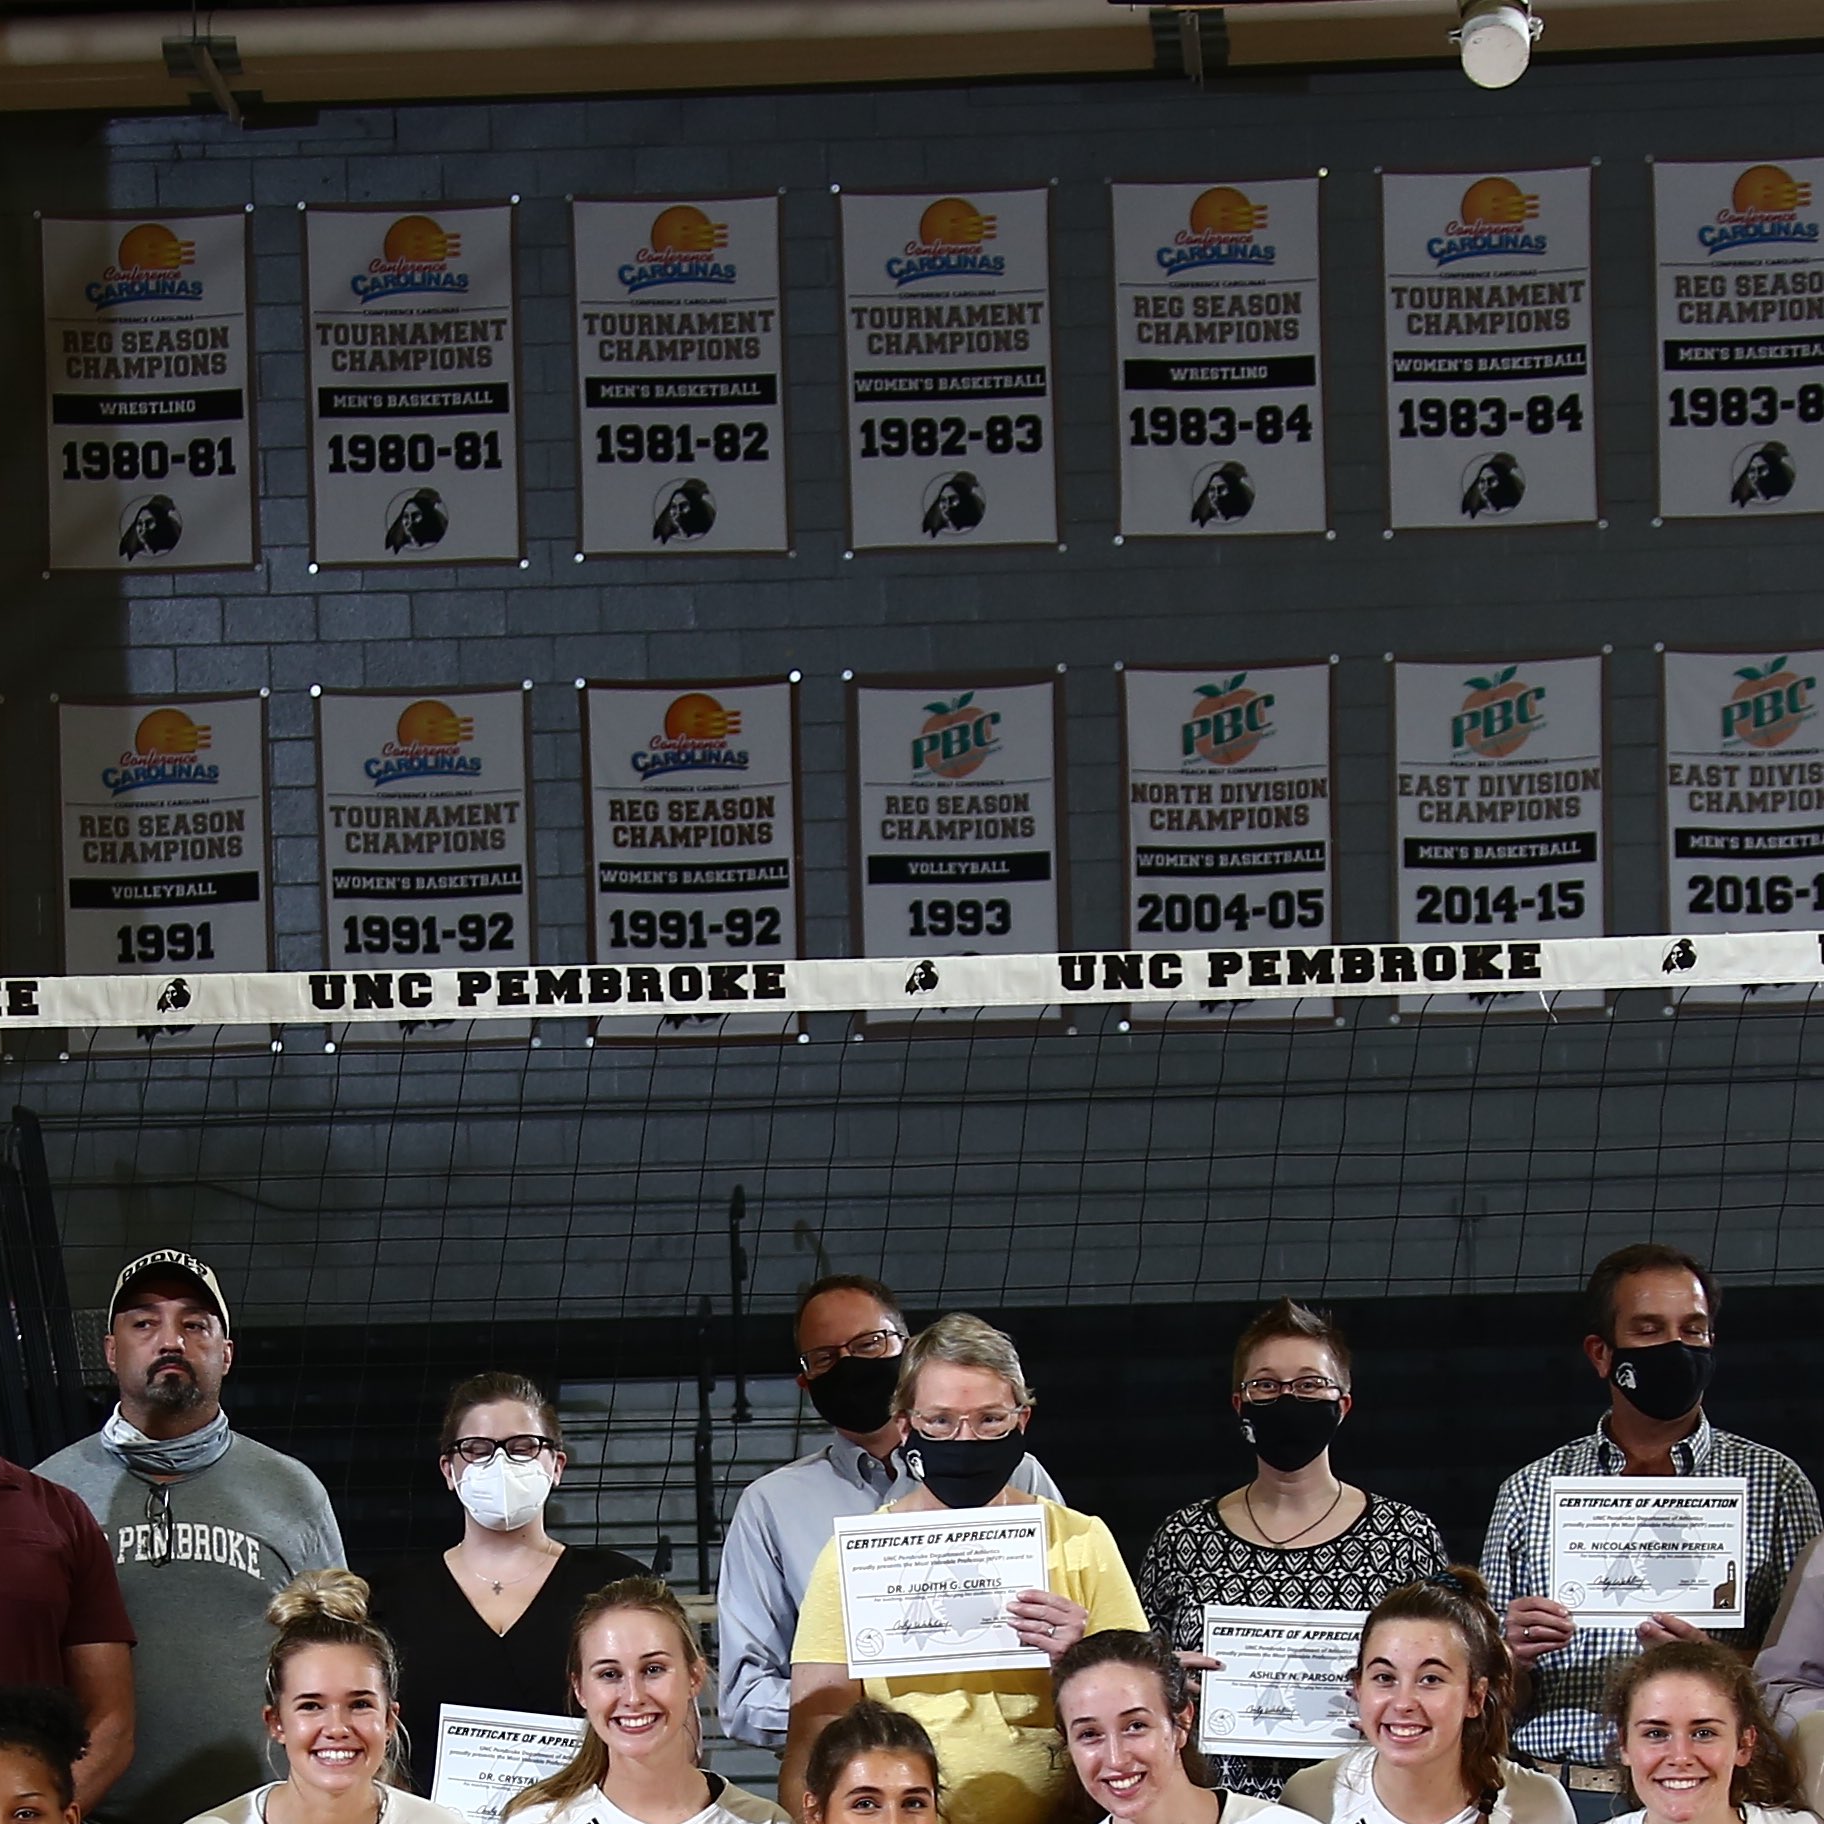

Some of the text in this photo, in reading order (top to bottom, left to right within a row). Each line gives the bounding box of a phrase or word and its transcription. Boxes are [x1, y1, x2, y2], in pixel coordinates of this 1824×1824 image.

[860, 415, 1043, 458] 1982-83
[1129, 405, 1312, 447] 1983-84
[1398, 395, 1583, 439] 1983-84
[63, 437, 237, 481] 1980-81
[328, 431, 503, 474] 1980-81
[596, 424, 770, 464] 1981-82
[908, 860, 1010, 876] VOLLEYBALL
[909, 898, 1011, 937] 1993
[1137, 889, 1325, 933] 2004-05
[1416, 879, 1585, 924] 2014-15
[117, 921, 215, 963] 1991
[343, 913, 515, 955] 1991-92
[609, 907, 781, 948] 1991-92
[310, 964, 786, 1011] UNC PEMBROKE
[1059, 943, 1542, 991] UNC PEMBROKE
[1559, 1498, 1738, 1508] CERTIFICATE OF APPRECIATION
[846, 1527, 1037, 1550] CERTIFICATE OF APPRECIATION
[1569, 1542, 1586, 1550] DR.
[1591, 1541, 1637, 1551] NICOLAS
[1681, 1542, 1724, 1551] PEREIRA
[887, 1584, 905, 1594] DR.
[908, 1582, 947, 1593] JUDITH
[963, 1578, 1002, 1589] CURTIS
[1212, 1626, 1302, 1639] CERTIFICATE OF
[1249, 1670, 1288, 1680] ASHLEY
[1301, 1672, 1349, 1683] PARSONS
[447, 1725, 535, 1743] CERTIFICATE OF
[479, 1772, 495, 1781] DR.
